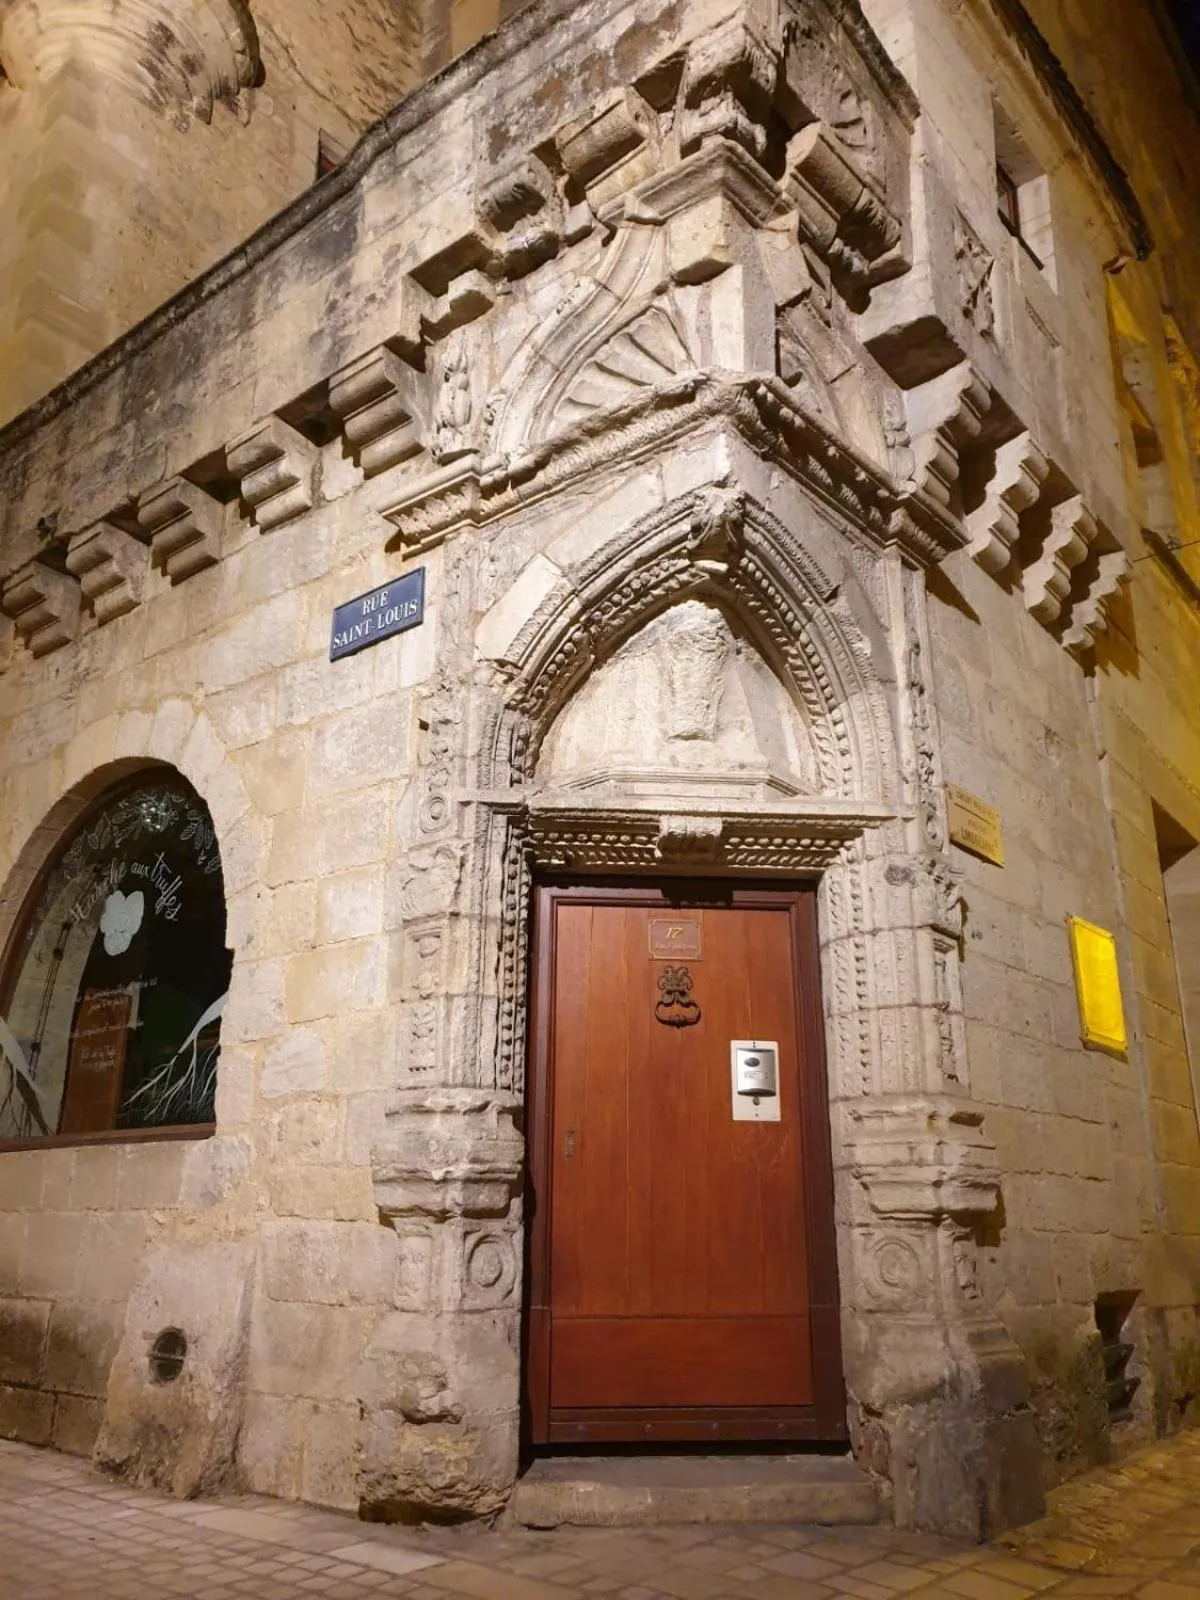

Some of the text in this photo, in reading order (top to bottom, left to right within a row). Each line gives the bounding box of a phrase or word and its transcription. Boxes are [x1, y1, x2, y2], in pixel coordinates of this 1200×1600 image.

[361, 591, 389, 616] RUE
[131, 861, 151, 879] aux
[665, 926, 684, 939] 17
